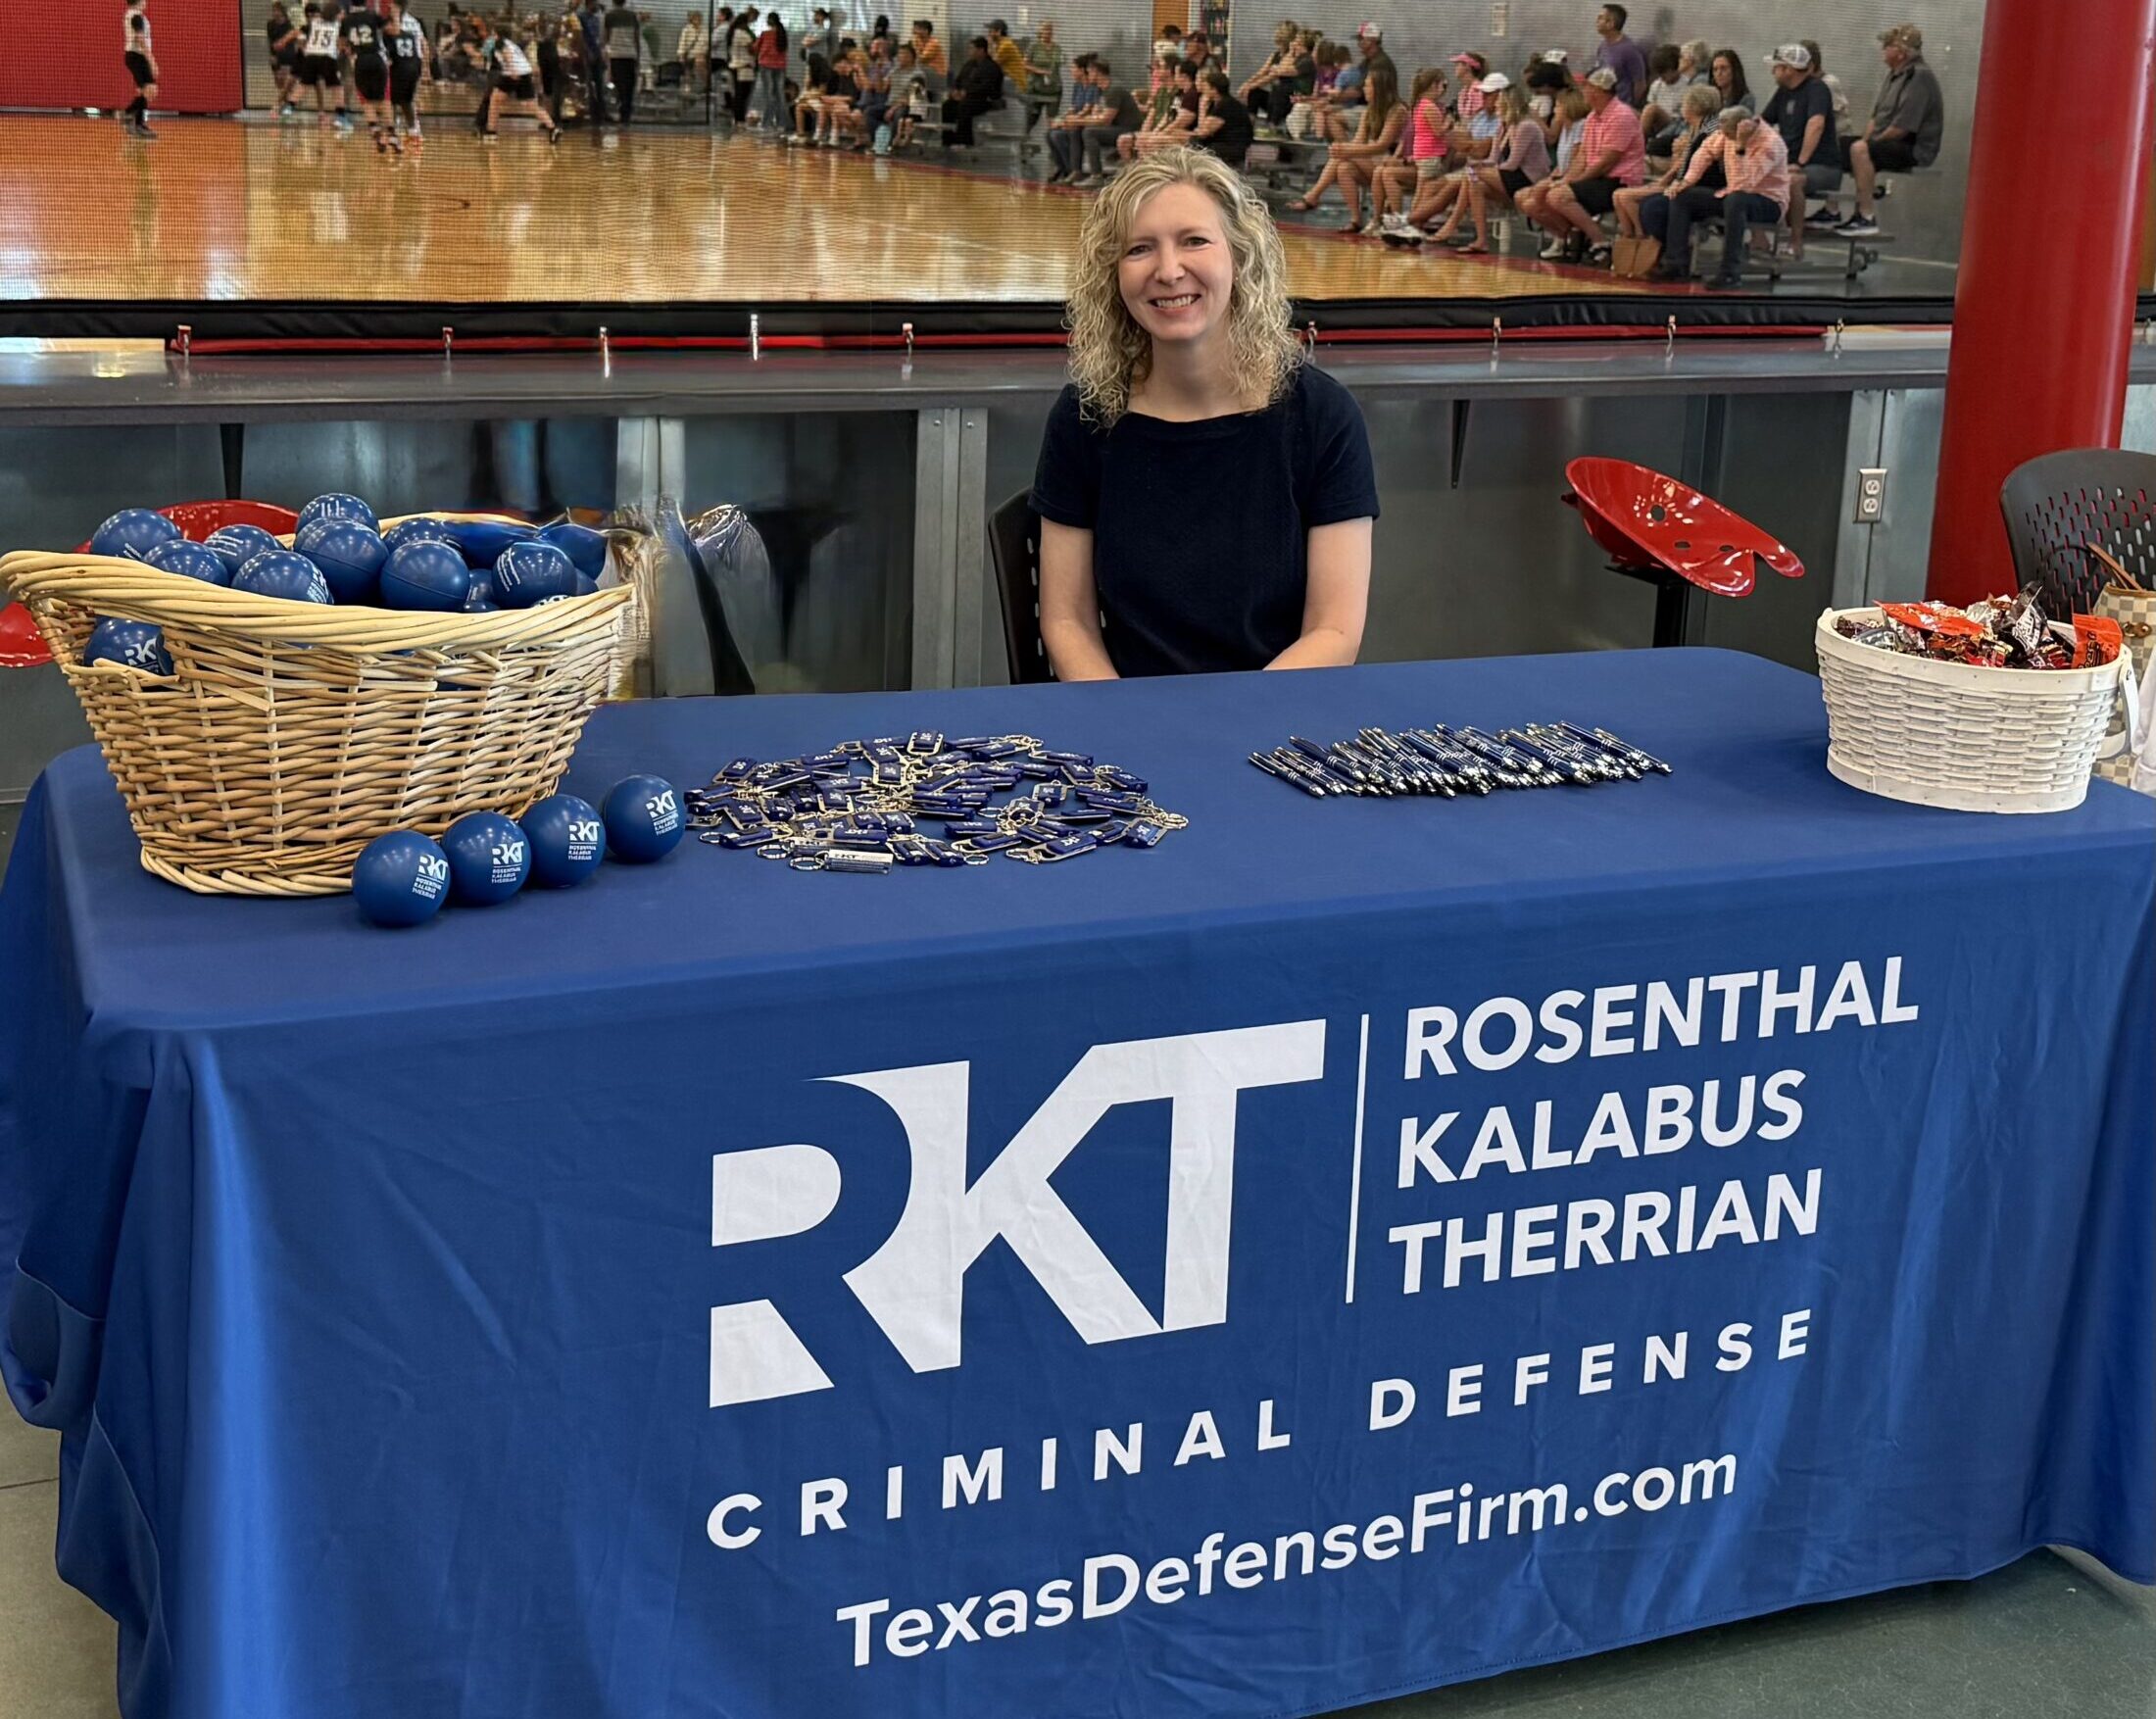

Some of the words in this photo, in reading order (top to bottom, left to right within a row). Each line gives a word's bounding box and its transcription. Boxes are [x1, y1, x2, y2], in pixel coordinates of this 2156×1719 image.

[124, 637, 157, 666] RK
[492, 841, 524, 864] RKT
[568, 821, 600, 841] RKT
[646, 790, 676, 818] RKT
[418, 854, 449, 881] RKT
[1404, 957, 1919, 1079] ROSENTHAL
[1398, 1069, 1806, 1189] KALABUS
[710, 1019, 1326, 1408] RKT
[1389, 1168, 1822, 1294] THERRIAN
[708, 1400, 1290, 1548] CRIMINAL
[1370, 1309, 1811, 1431] DEFENSE
[837, 1454, 1737, 1667] TexasDefenseFirm.com
